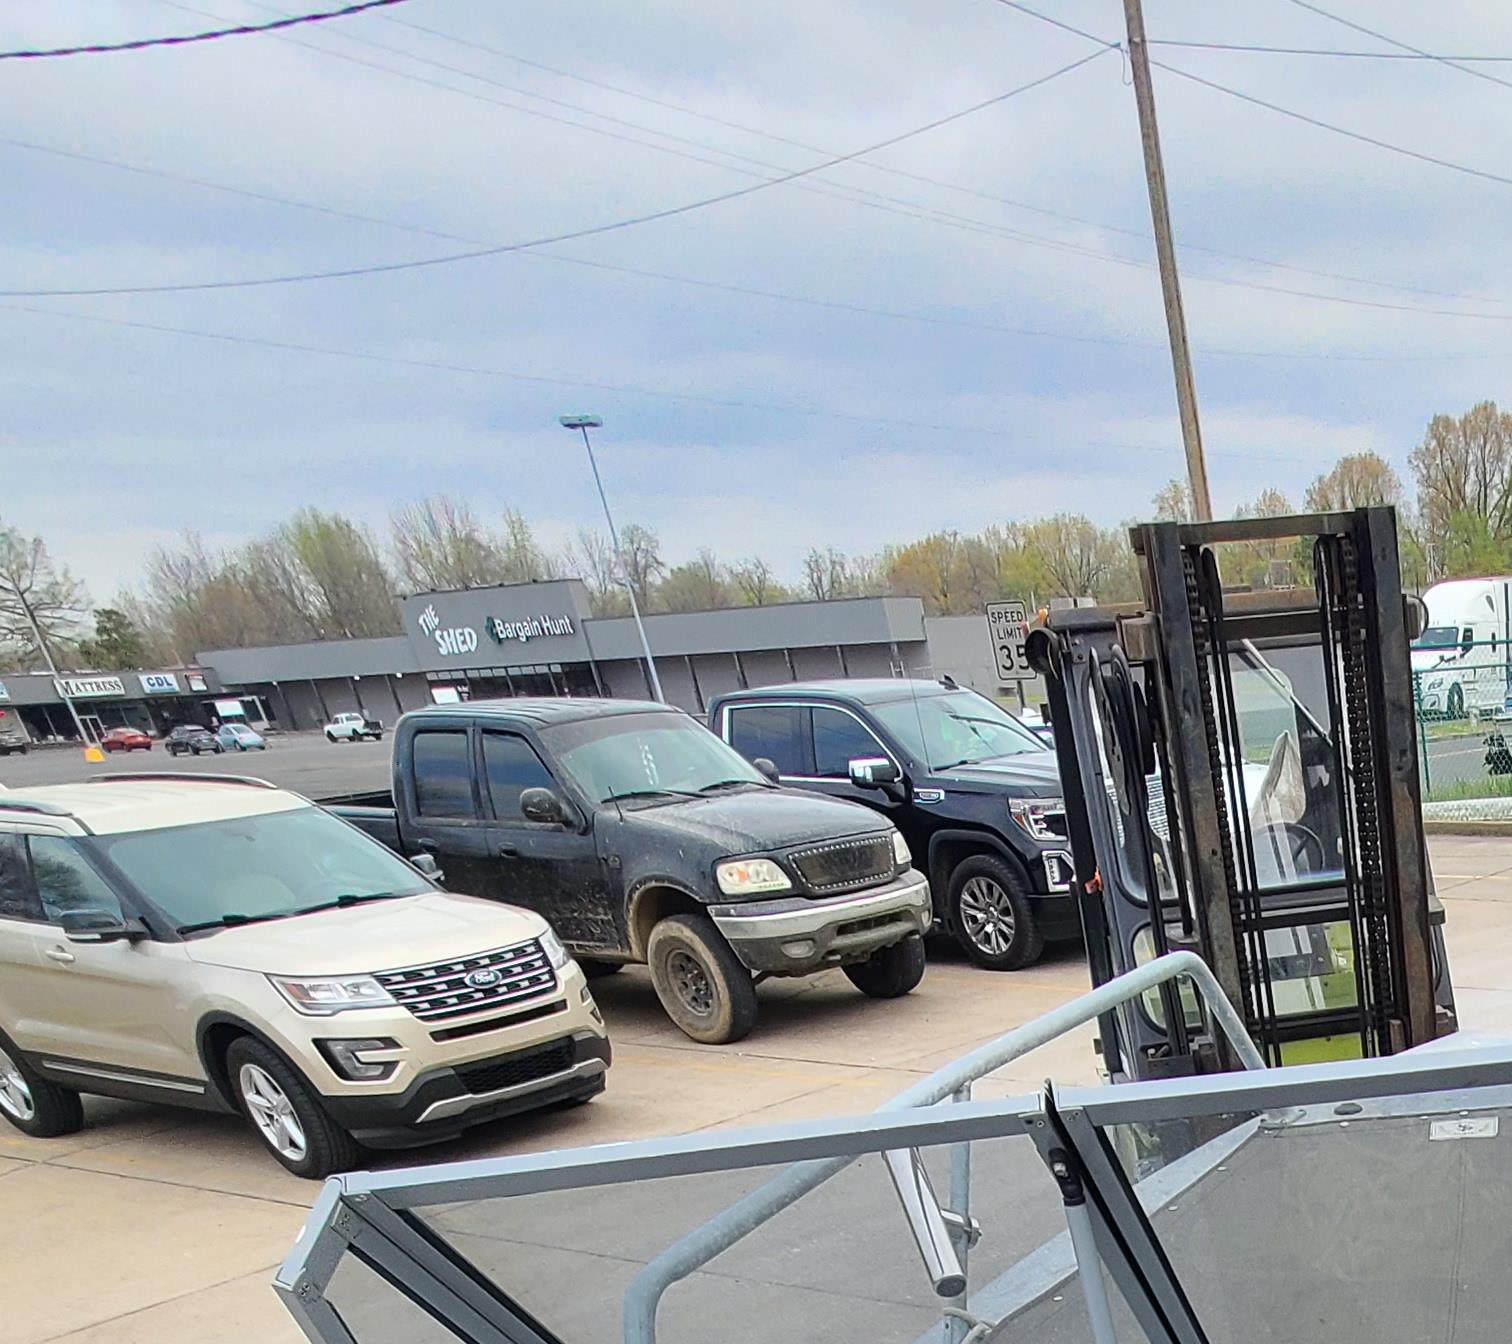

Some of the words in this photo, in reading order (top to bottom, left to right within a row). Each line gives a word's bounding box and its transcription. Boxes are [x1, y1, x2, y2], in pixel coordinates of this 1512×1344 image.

[418, 604, 440, 637] THE
[991, 611, 1023, 623] SPEED
[495, 616, 543, 643] Bargain
[541, 614, 574, 636] Hunt
[997, 626, 1022, 640] LIMIT
[434, 627, 479, 656] SHED
[1000, 645, 1030, 671] 35
[63, 680, 122, 696] MATTRESS
[146, 676, 174, 688] CDL
